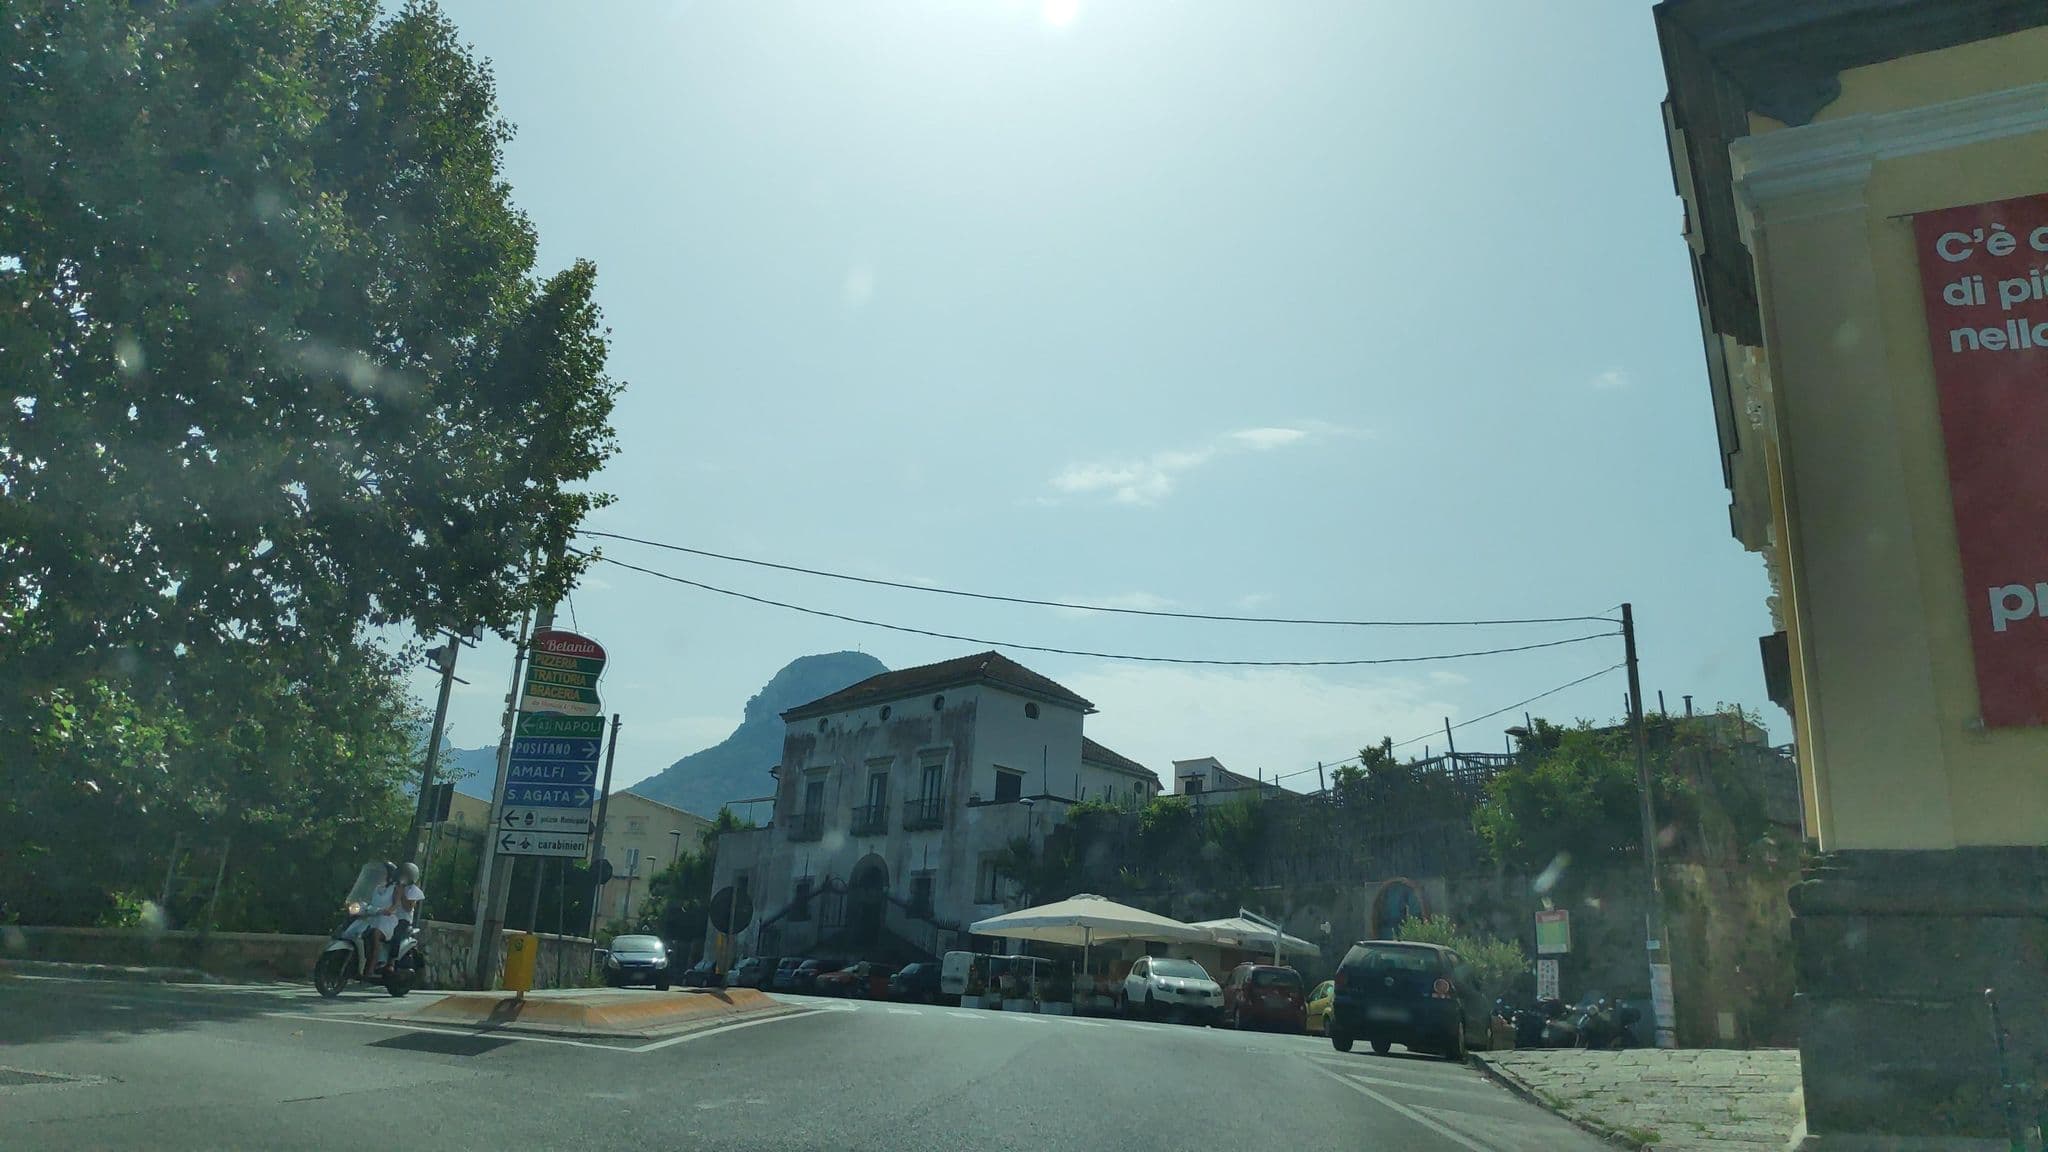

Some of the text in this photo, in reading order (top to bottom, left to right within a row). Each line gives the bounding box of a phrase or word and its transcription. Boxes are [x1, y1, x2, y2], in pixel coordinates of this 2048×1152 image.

[1936, 223, 2016, 262] C'è
[1943, 265, 2048, 310] di pi
[546, 639, 595, 653] Betania
[534, 653, 577, 668] PIZZERIA
[533, 669, 586, 686] TRATTORIA
[530, 684, 580, 700] BRACERIA
[555, 721, 601, 732] NAPOLI
[515, 742, 571, 755] POSITANO
[511, 766, 565, 778] AMALFI
[507, 789, 570, 802] S. AGATA
[538, 839, 585, 851] carabinieri
